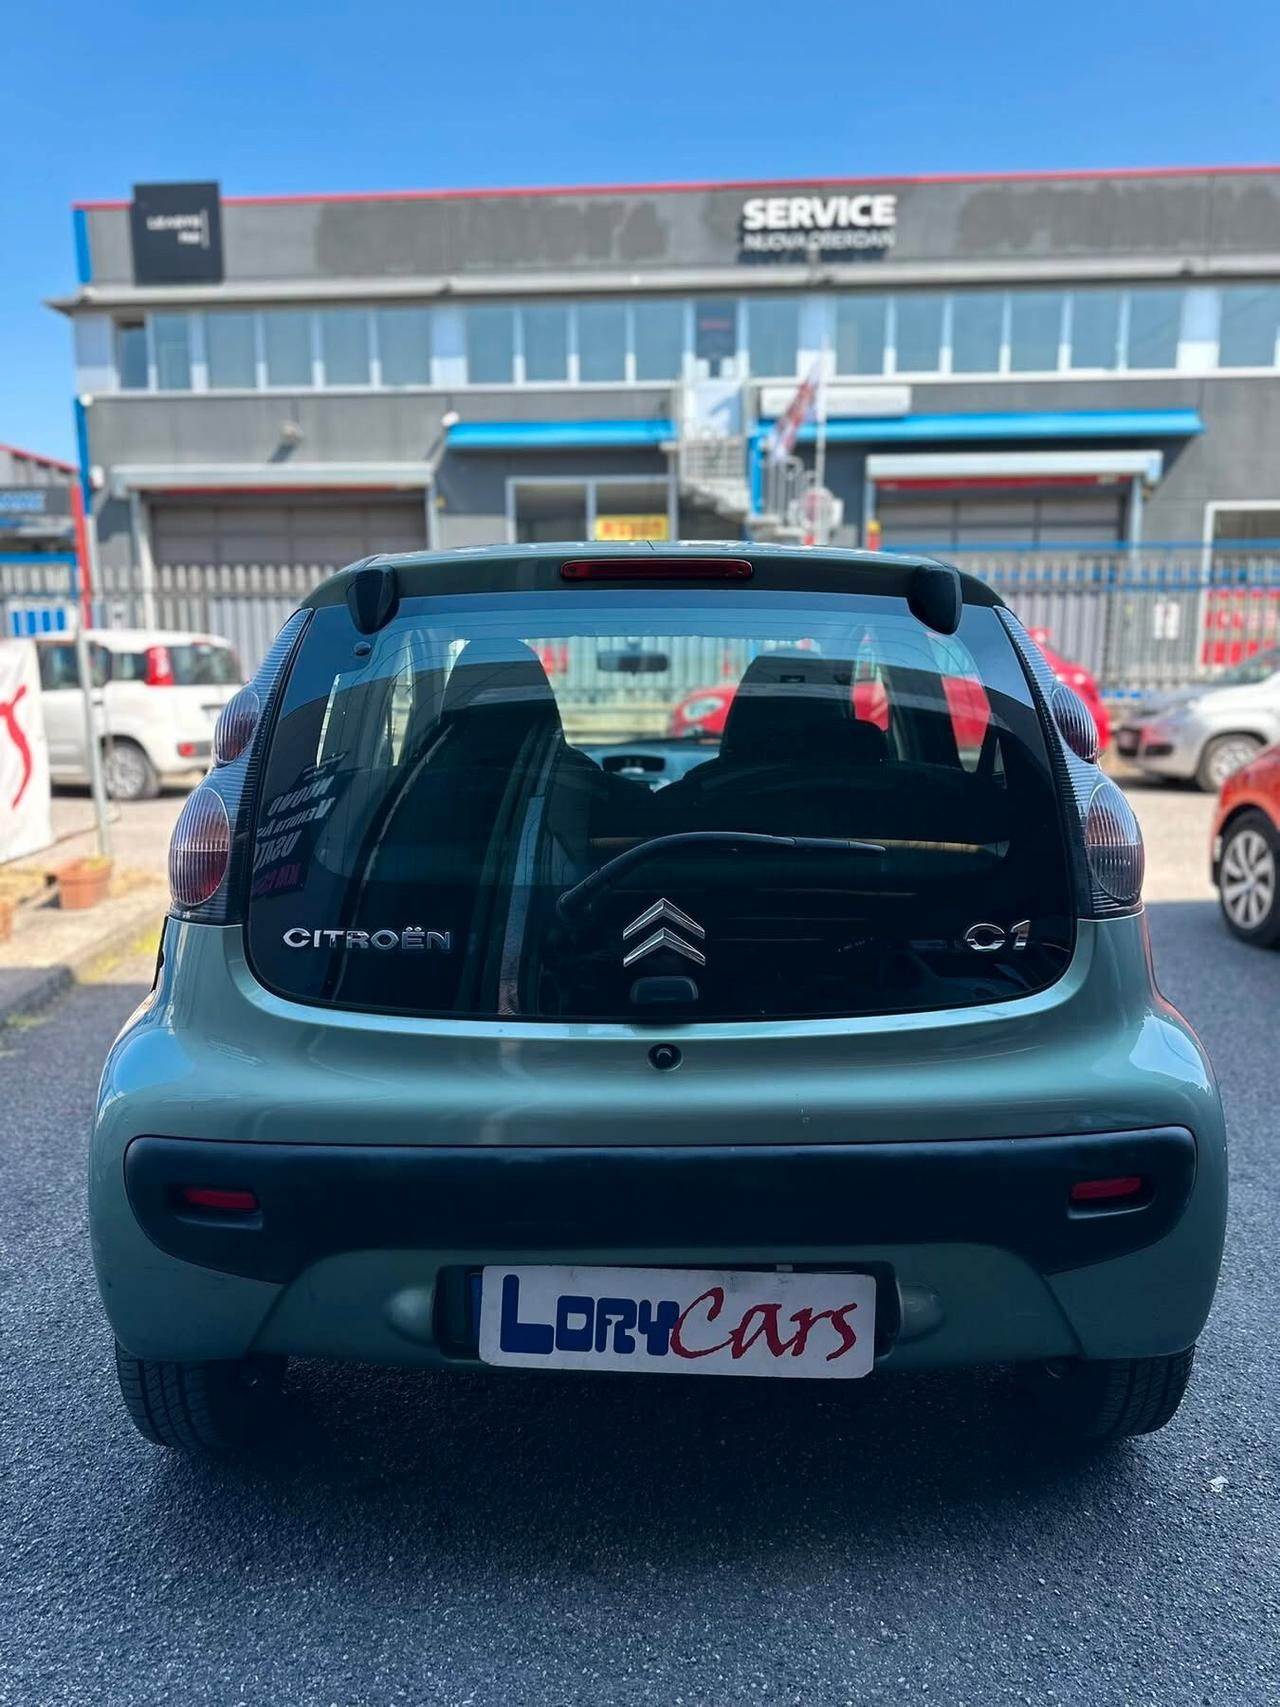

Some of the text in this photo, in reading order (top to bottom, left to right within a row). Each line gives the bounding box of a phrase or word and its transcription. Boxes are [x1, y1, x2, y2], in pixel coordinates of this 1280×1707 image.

[743, 195, 897, 230] SERVICE
[744, 232, 804, 251] NUOVA
[282, 926, 451, 949] CITROËN
[963, 919, 1031, 951] C1
